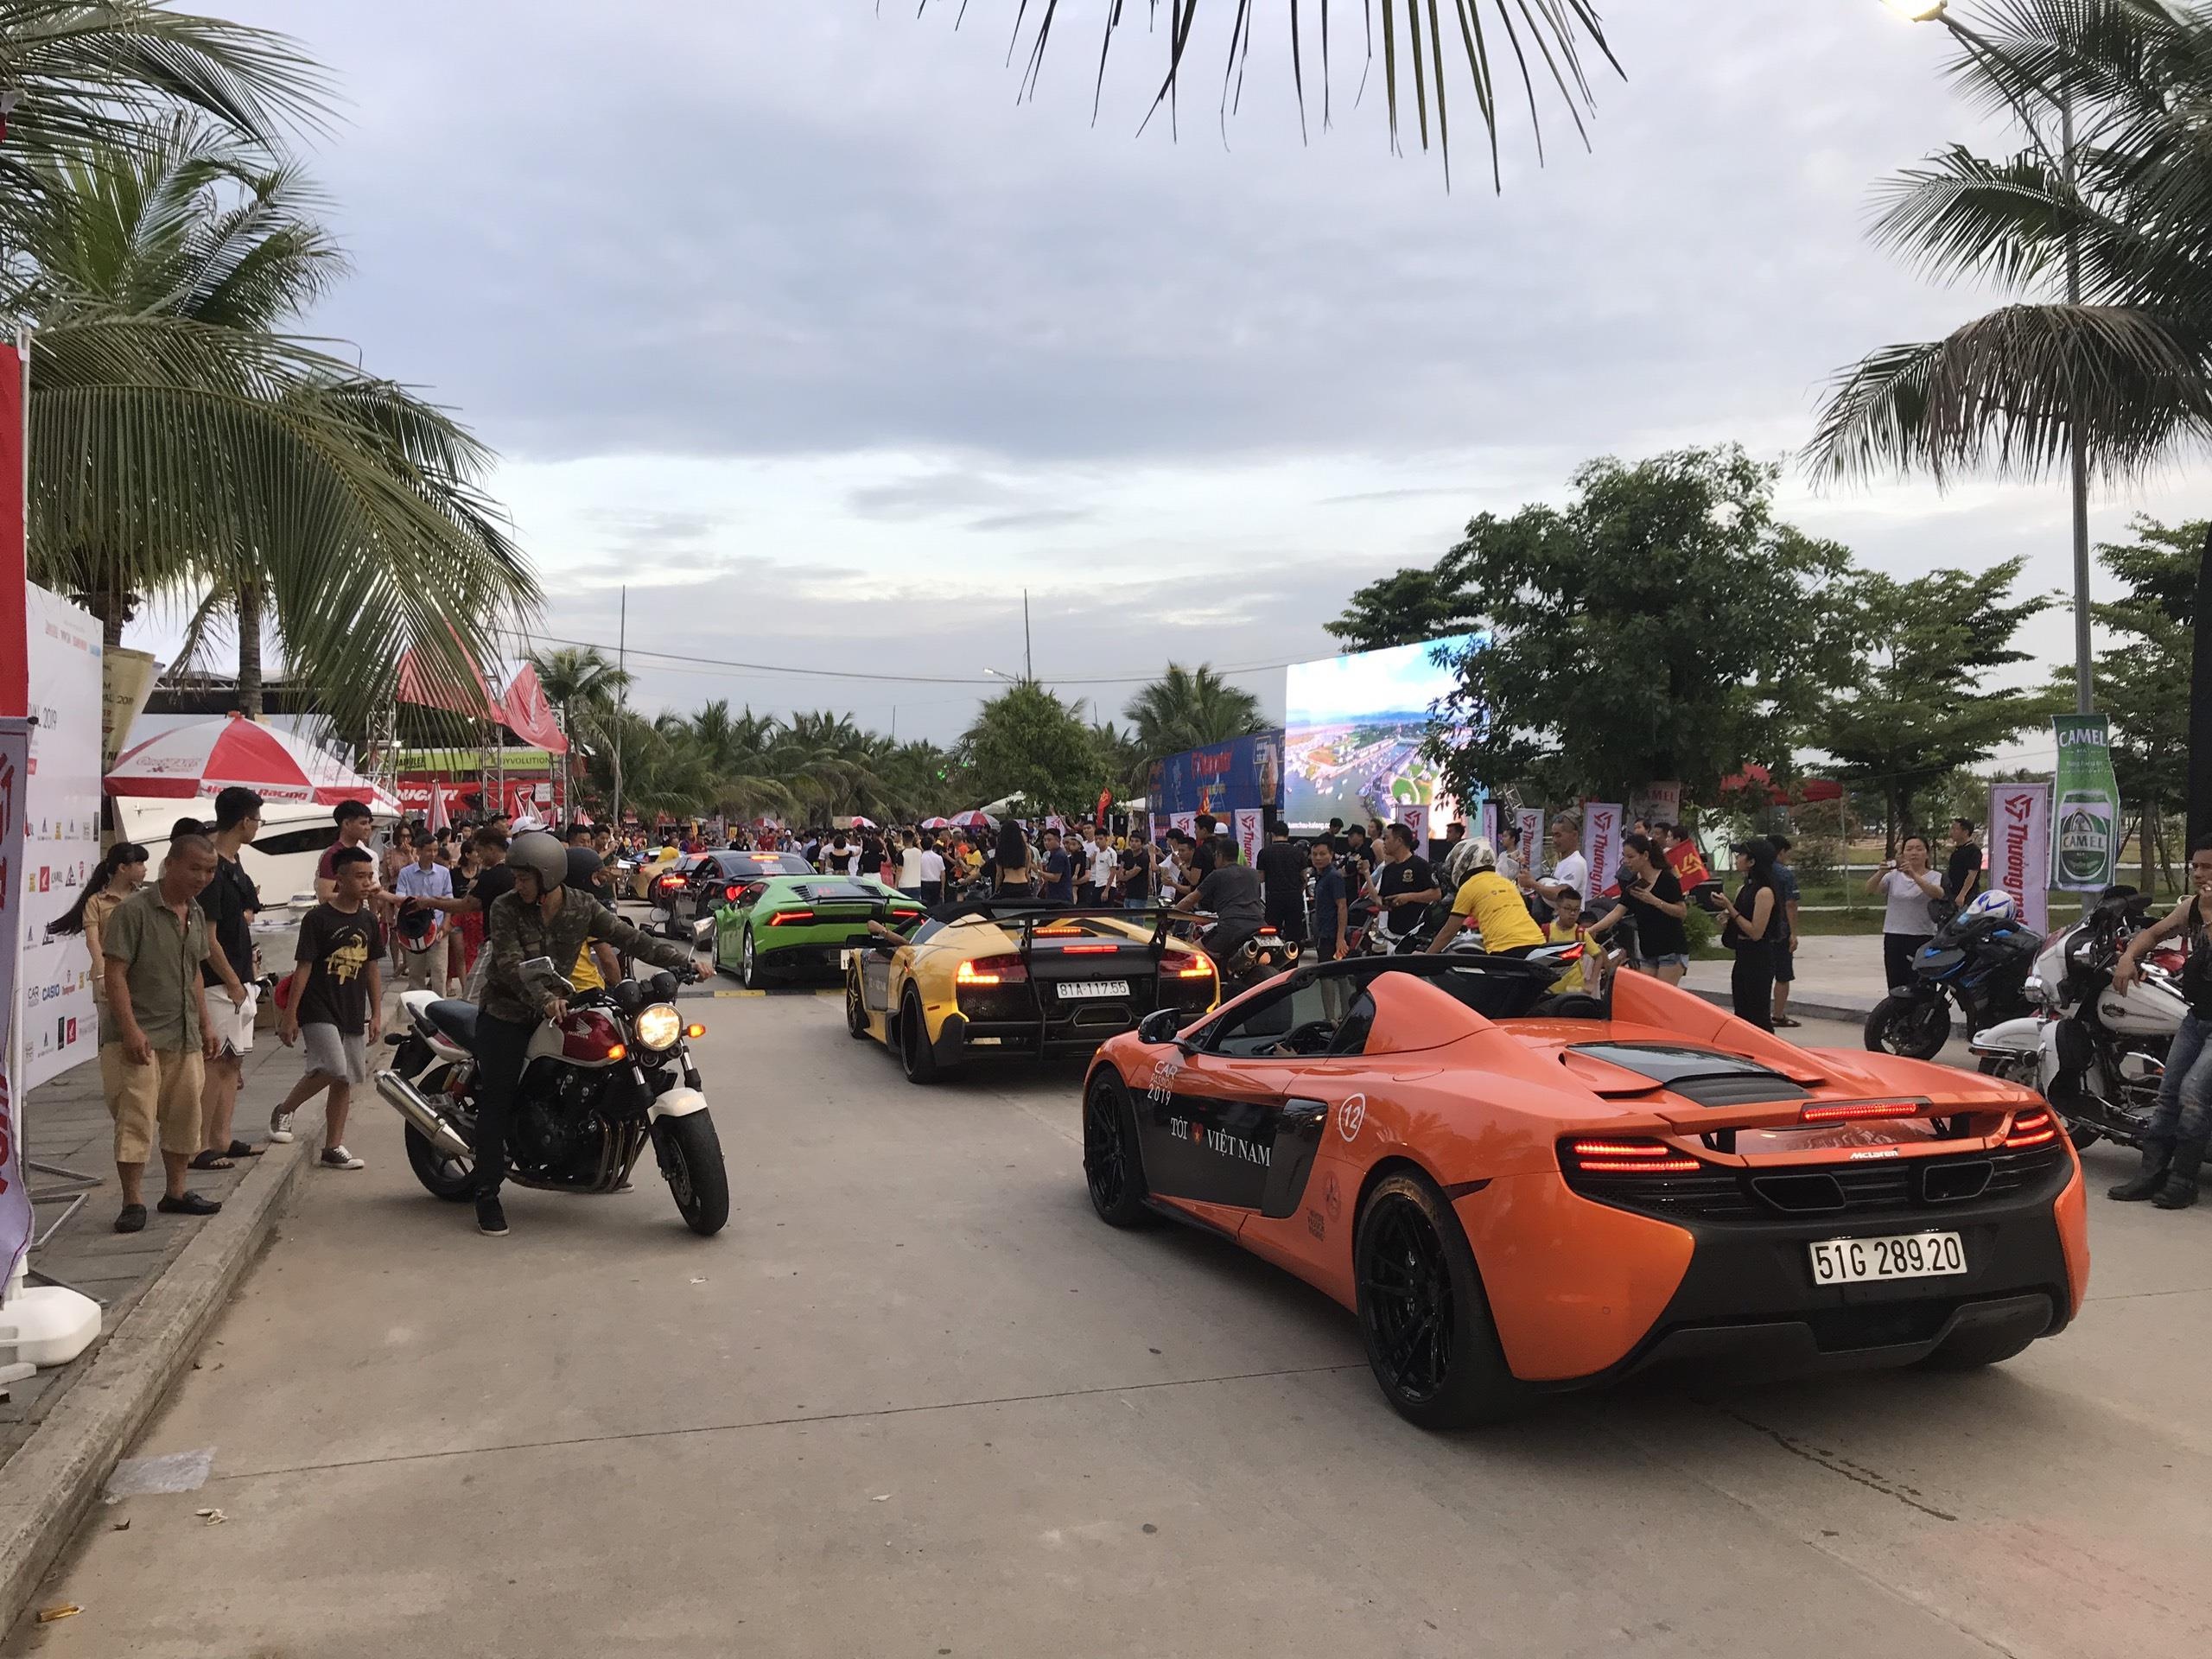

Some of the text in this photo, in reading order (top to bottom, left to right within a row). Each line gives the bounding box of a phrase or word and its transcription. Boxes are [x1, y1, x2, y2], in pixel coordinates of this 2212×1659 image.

[2058, 728, 2107, 747] CAMEL
[257, 788, 308, 801] Racing
[2063, 835, 2104, 849] CAMEL
[41, 983, 60, 1001] CASIO
[1058, 982, 1127, 997] 81A-117.55
[1154, 1060, 1178, 1079] CAR
[1147, 1084, 1172, 1106] 2019
[1344, 1103, 1362, 1129] 12
[1170, 1115, 1271, 1166] TÔI VIỆT NAM
[1815, 1236, 1961, 1280] 51G 289.20
